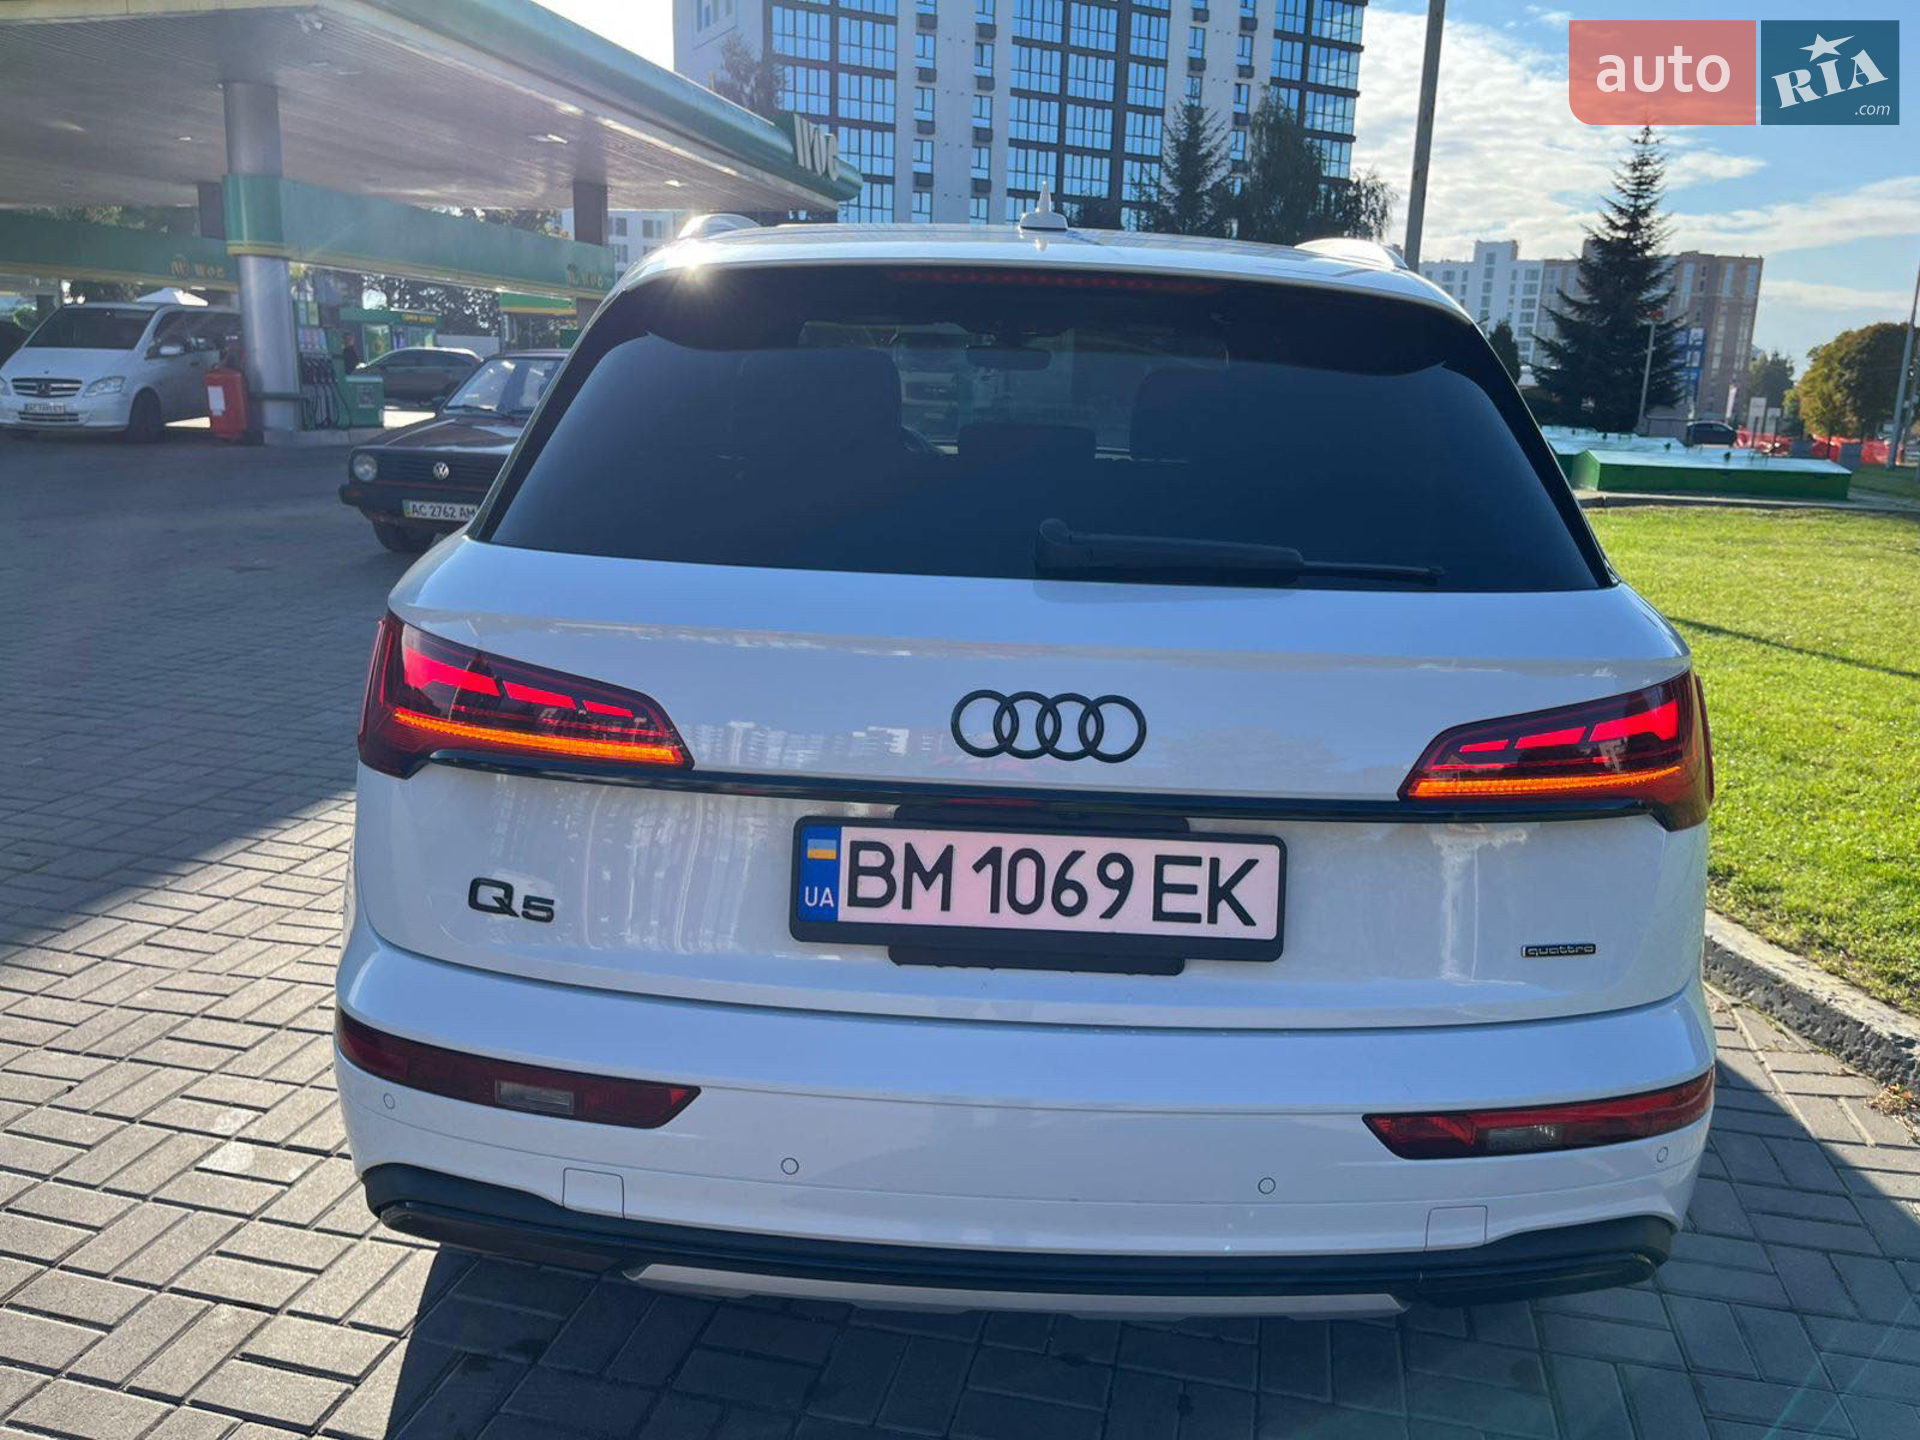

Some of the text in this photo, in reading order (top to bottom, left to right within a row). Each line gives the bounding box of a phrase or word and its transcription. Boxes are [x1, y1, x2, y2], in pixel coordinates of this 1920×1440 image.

[412, 504, 428, 516] AC
[429, 504, 456, 518] 2762
[847, 839, 1260, 926] BM 1069 EK
[467, 876, 555, 923] Q5
[804, 885, 835, 908] UA
[1527, 944, 1594, 957] quattro
